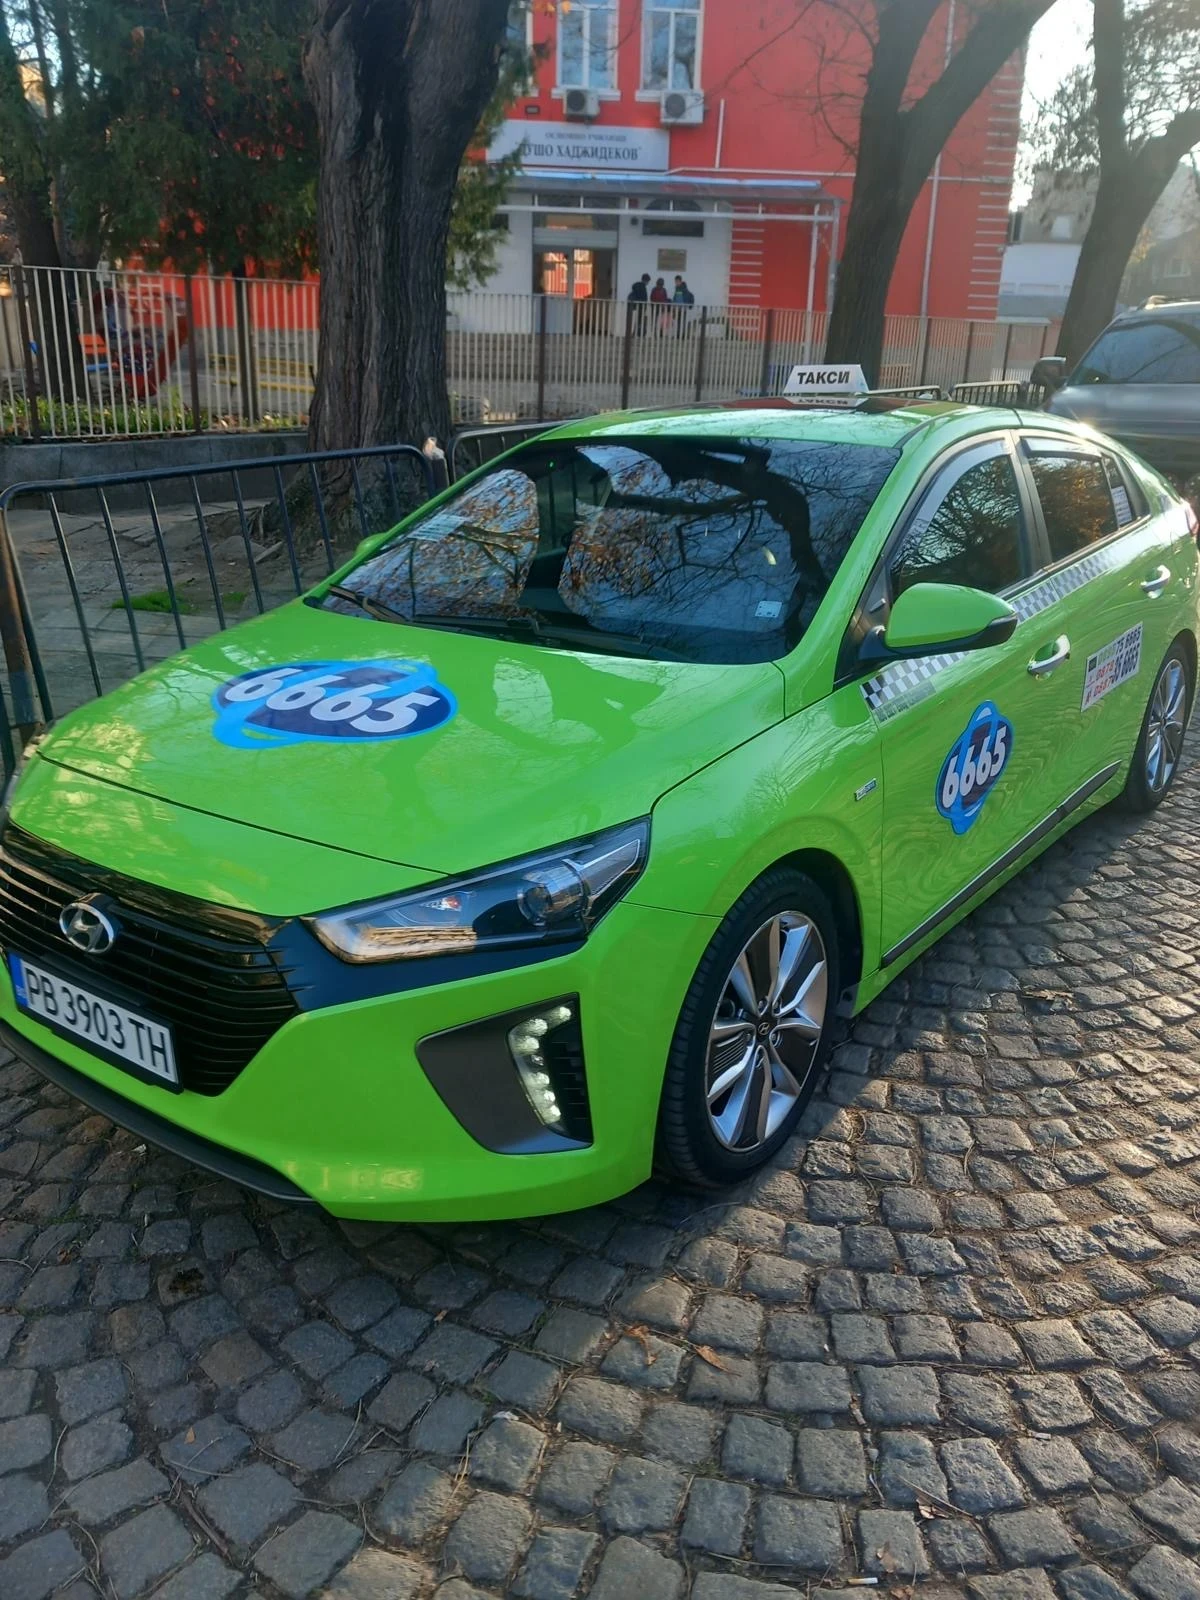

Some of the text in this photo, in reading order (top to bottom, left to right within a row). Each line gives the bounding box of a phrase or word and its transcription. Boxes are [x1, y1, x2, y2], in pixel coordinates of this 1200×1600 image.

[797, 371, 850, 384] ТАКСИ
[225, 667, 440, 733] 6665
[943, 725, 1007, 808] 6665
[25, 967, 170, 1074] PB 3903 TH
